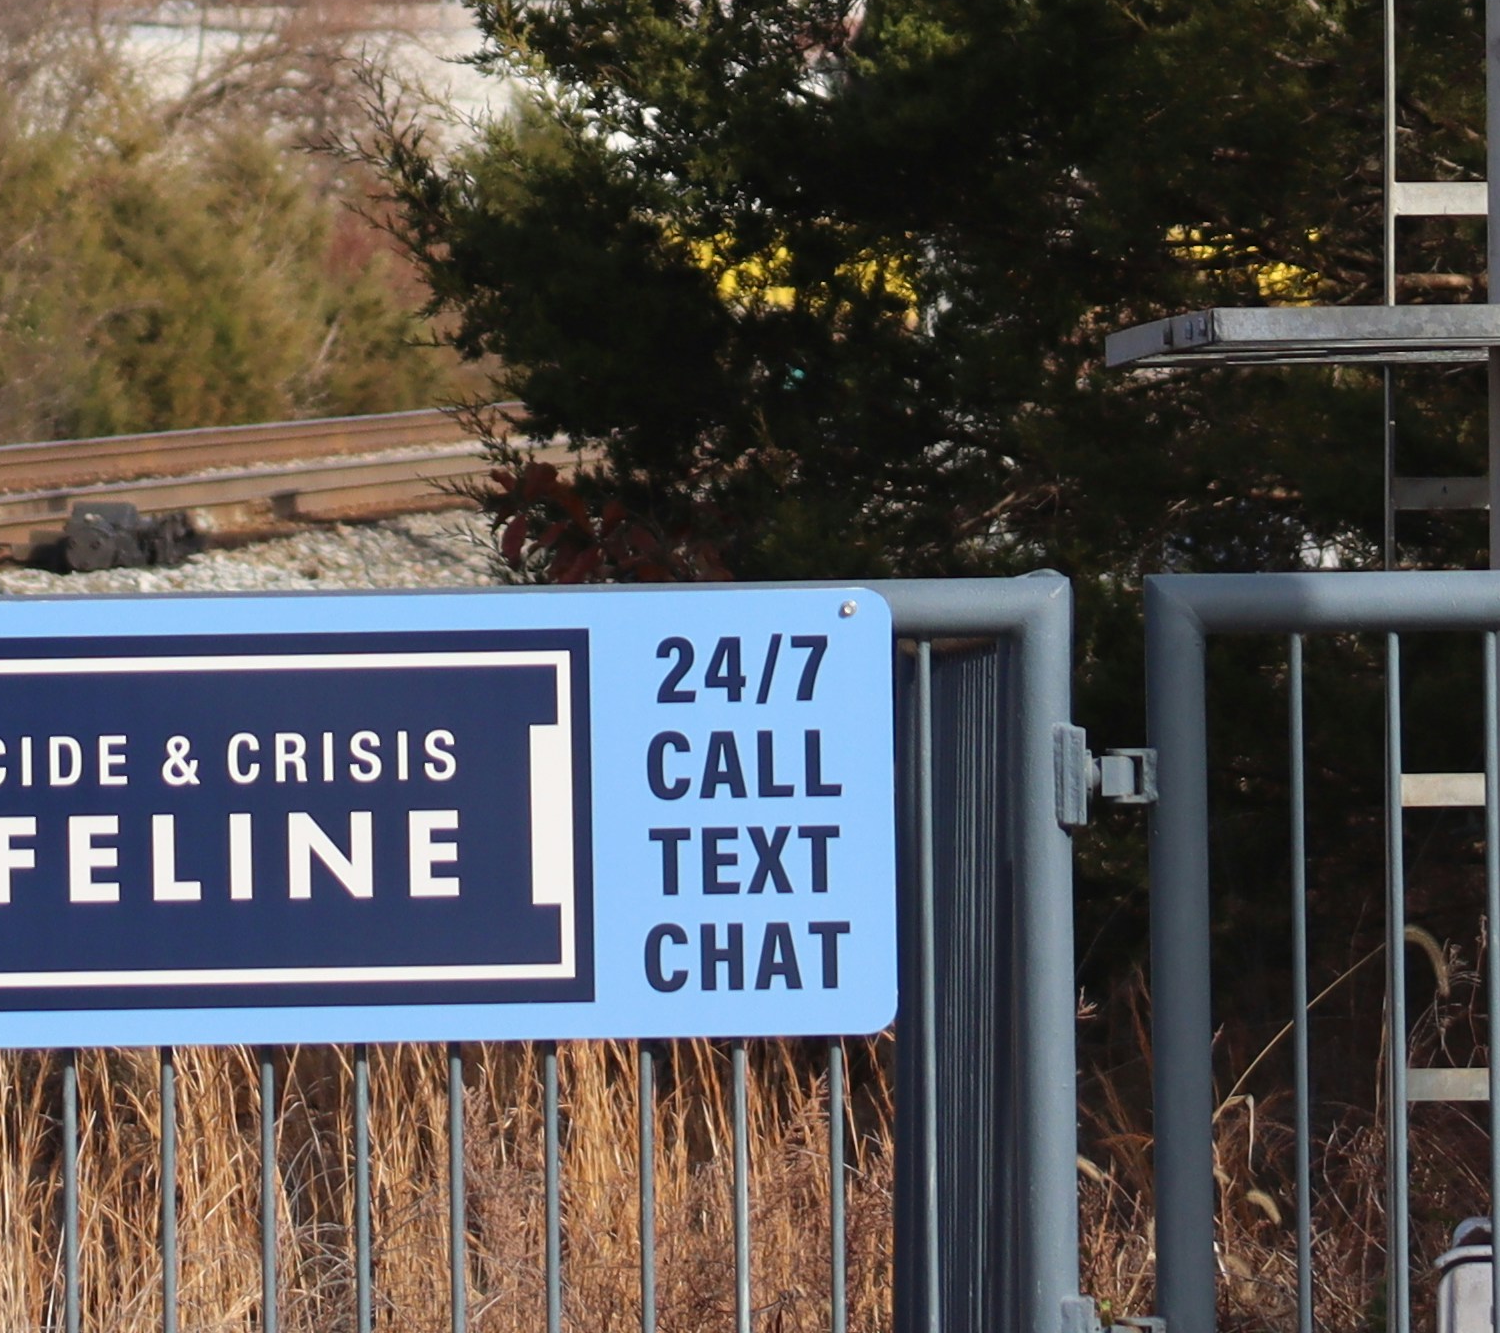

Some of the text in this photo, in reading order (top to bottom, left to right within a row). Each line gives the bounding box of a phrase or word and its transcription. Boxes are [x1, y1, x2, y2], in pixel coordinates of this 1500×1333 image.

[657, 634, 828, 704] 24/7
[163, 736, 201, 786] &
[228, 730, 457, 783] CRISIS
[647, 730, 842, 800] CALL
[649, 826, 840, 896] TEXT
[645, 922, 851, 993] CHAT
